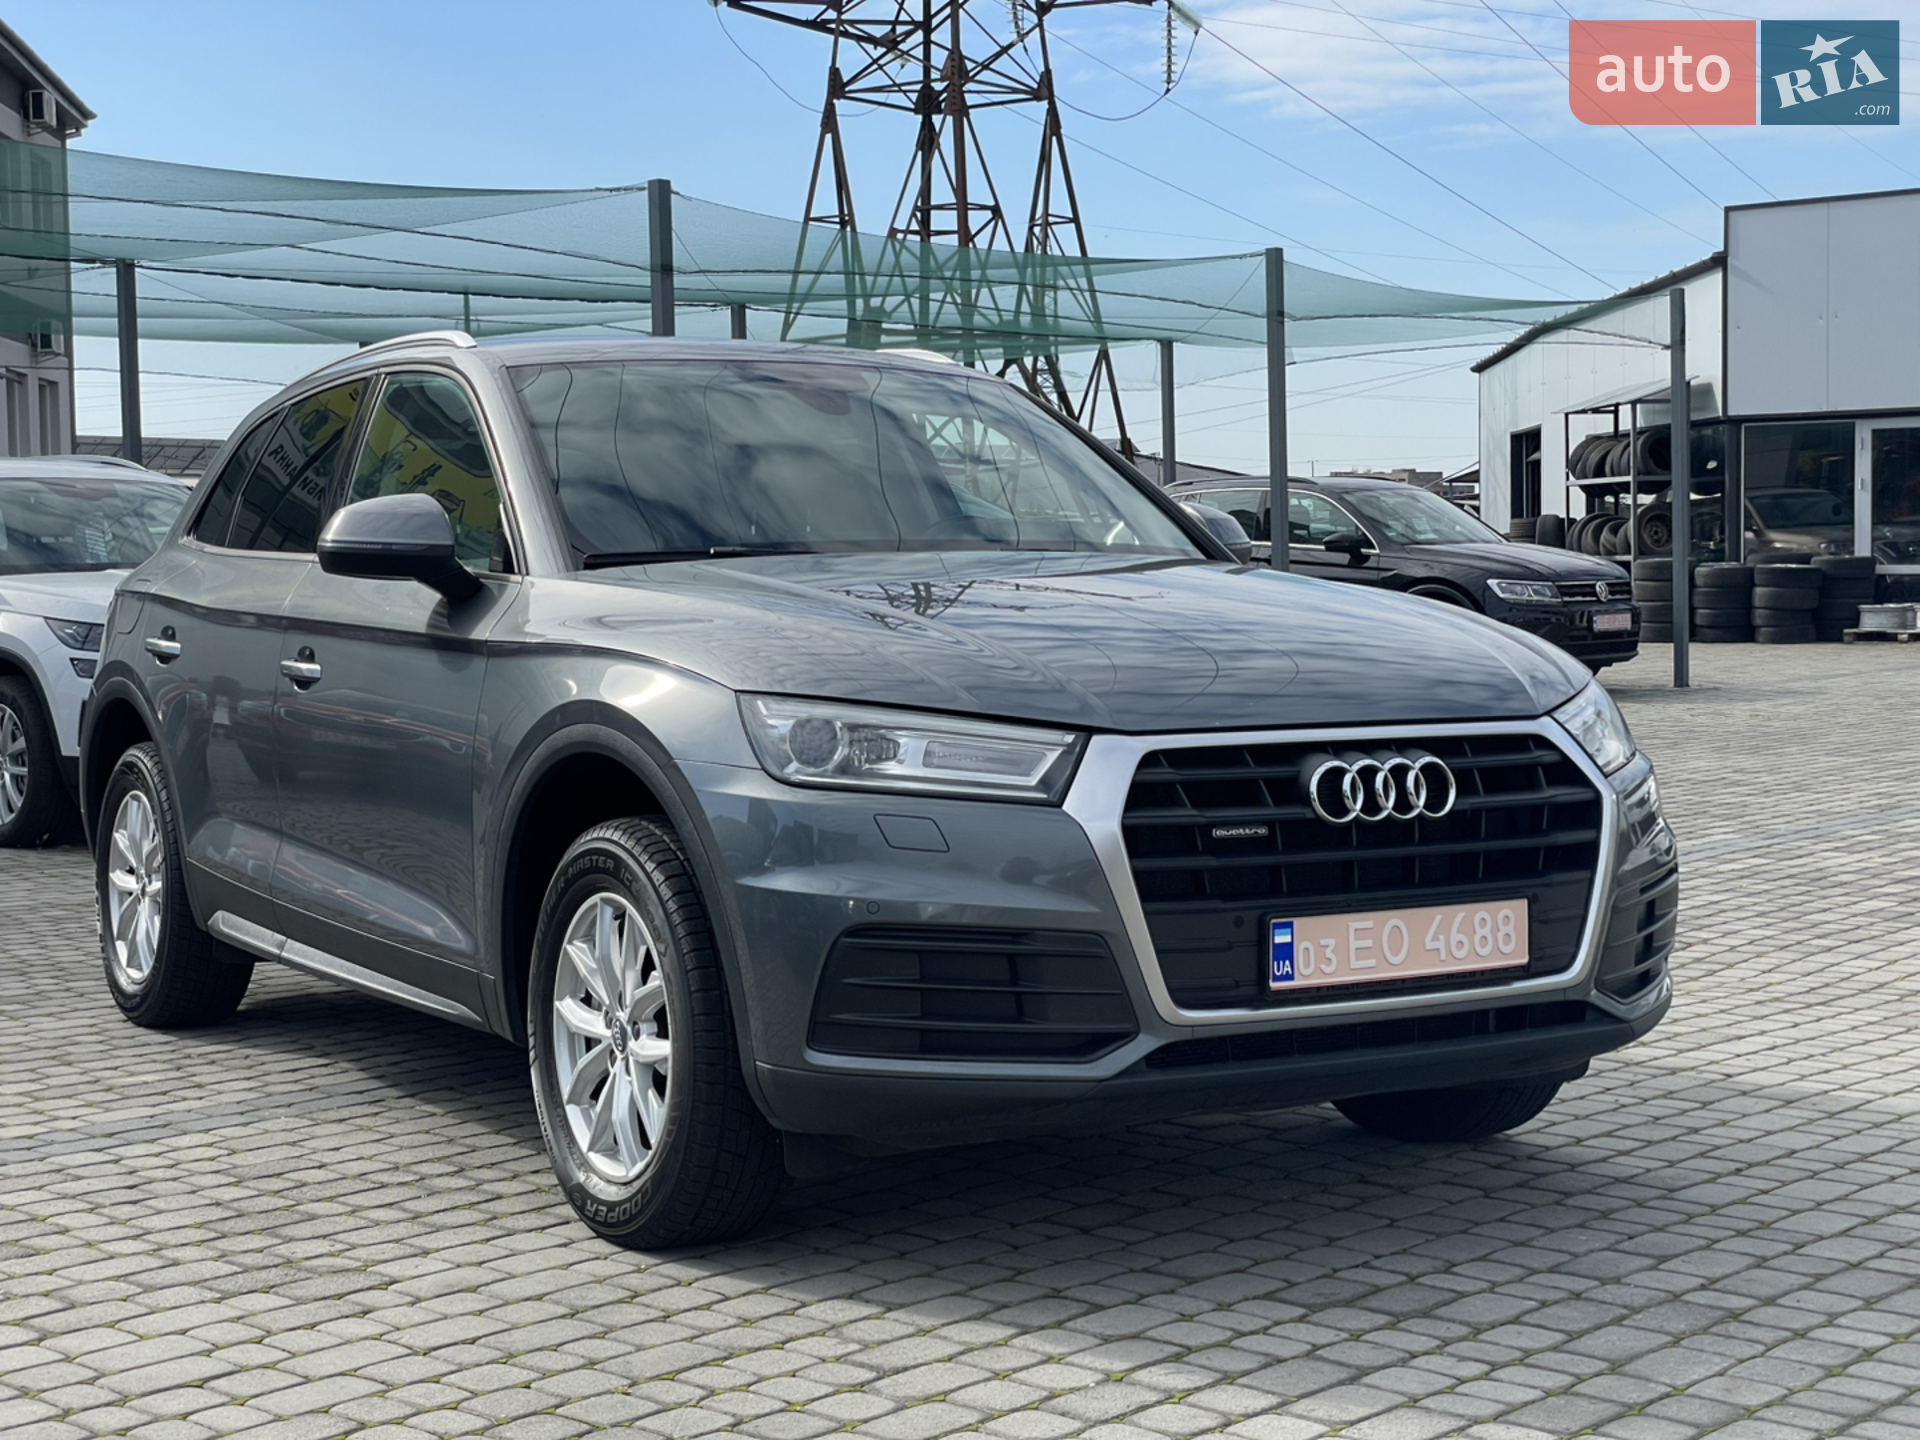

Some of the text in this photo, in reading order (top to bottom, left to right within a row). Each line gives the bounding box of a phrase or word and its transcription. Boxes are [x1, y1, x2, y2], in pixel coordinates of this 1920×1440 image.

[1215, 826, 1266, 837] quattro
[1298, 908, 1517, 976] 03 EO 4688
[1273, 959, 1293, 977] UA
[584, 1181, 651, 1223] COOPER
